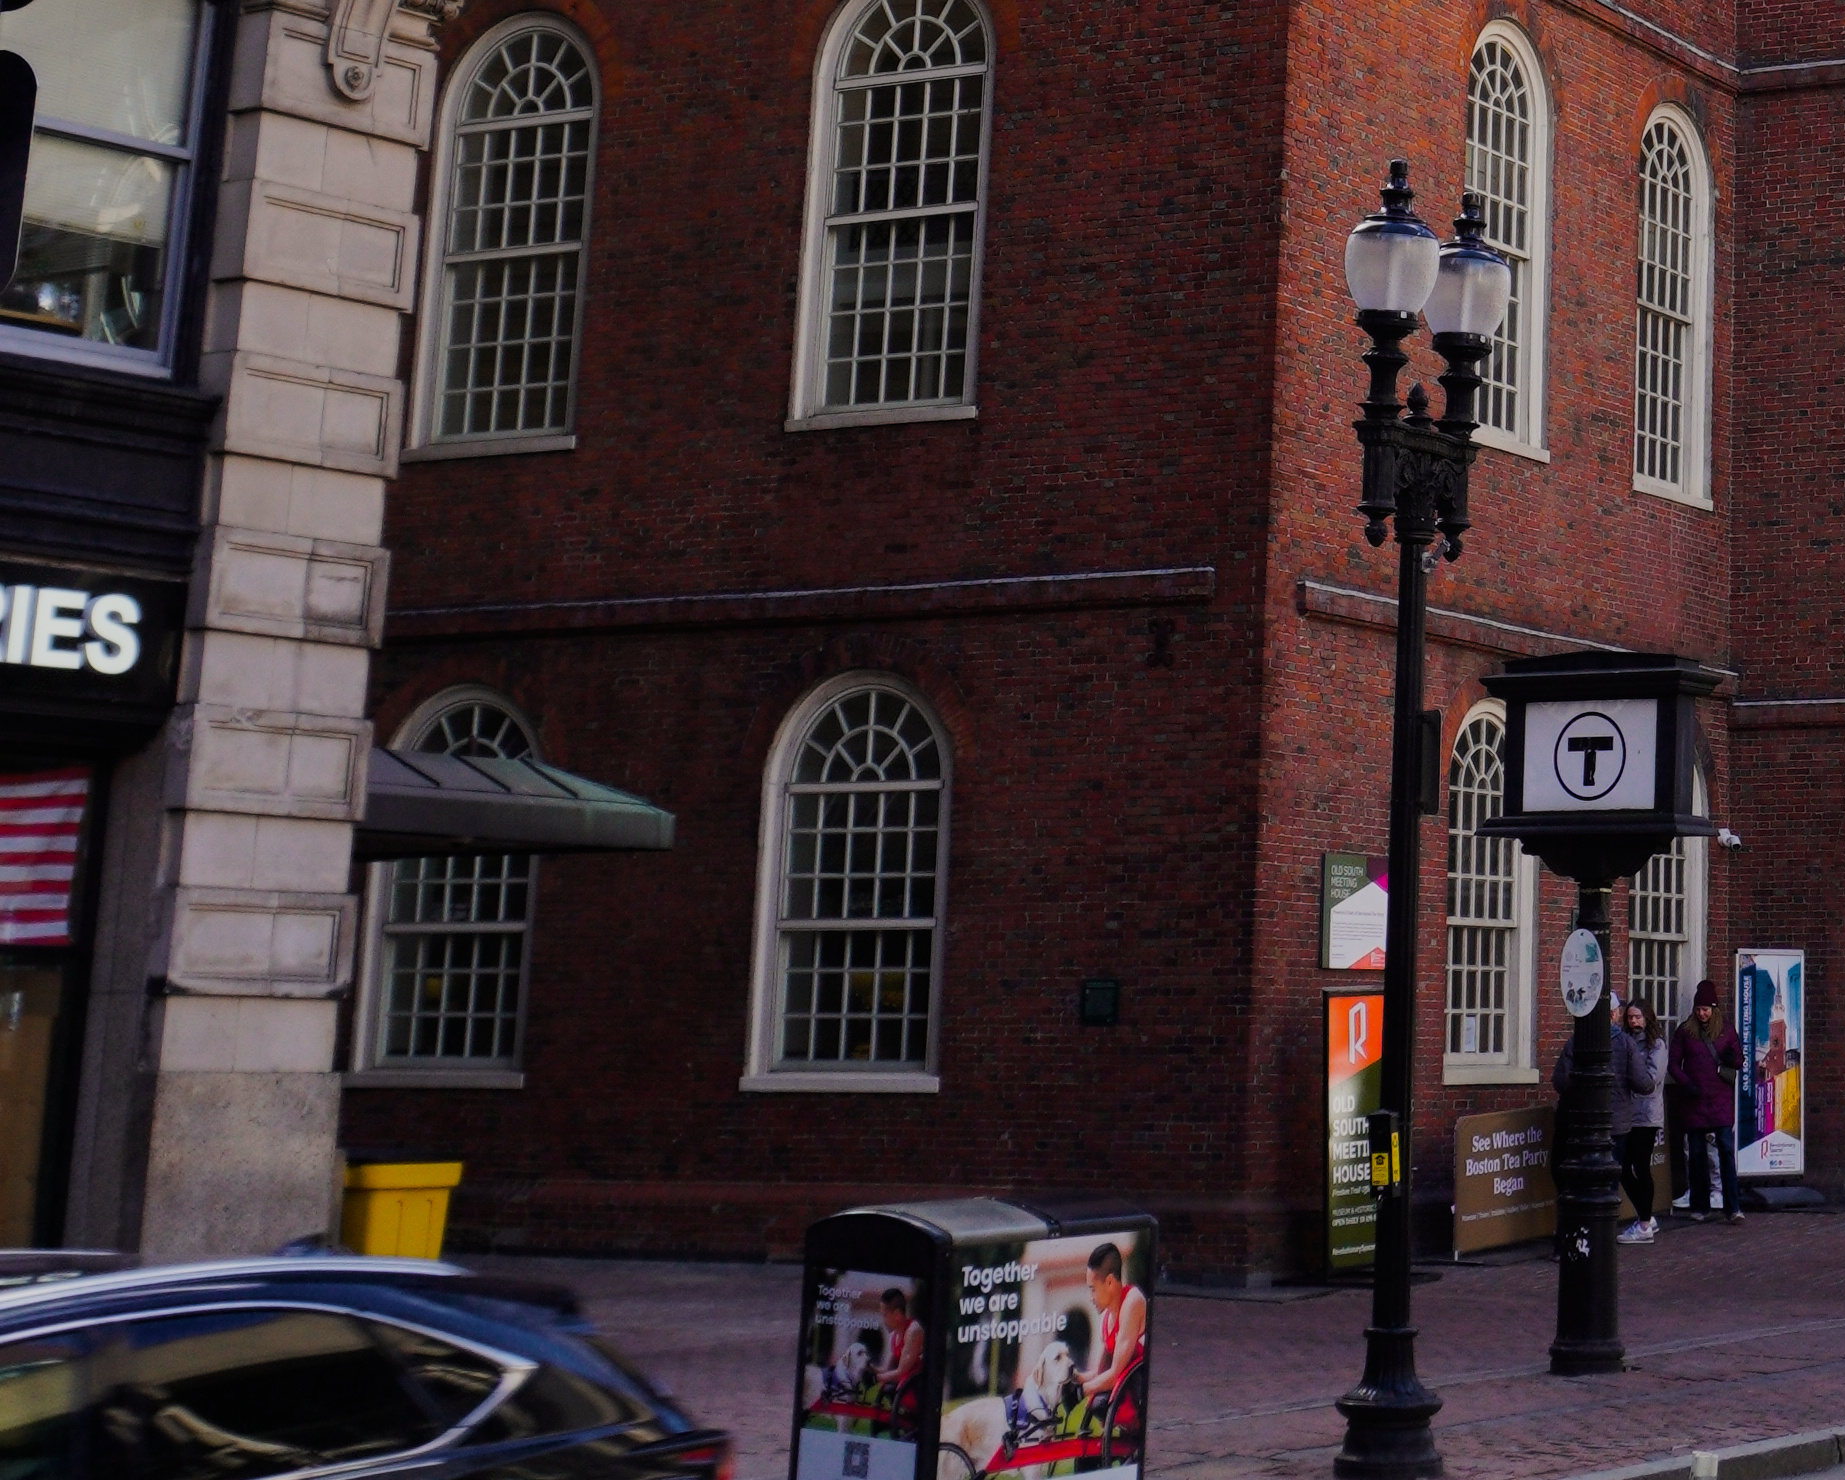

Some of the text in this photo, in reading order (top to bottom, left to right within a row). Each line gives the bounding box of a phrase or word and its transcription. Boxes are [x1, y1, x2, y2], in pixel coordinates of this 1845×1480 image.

[0, 580, 142, 675] IES
[1333, 1095, 1355, 1113] OLD
[1333, 1117, 1370, 1137] SOUTH
[1472, 1126, 1543, 1152] See Where the
[1333, 1141, 1370, 1161] MEETI
[1465, 1150, 1548, 1176] Boston Tea Party
[1333, 1164, 1370, 1184] HOUSE
[1493, 1177, 1524, 1196] Began
[961, 1260, 1038, 1294] Together
[818, 1284, 862, 1300] Together
[816, 1300, 831, 1310] we
[959, 1292, 1018, 1315] we are
[815, 1314, 879, 1330] unstoppable
[957, 1312, 1068, 1345] unstoppable
